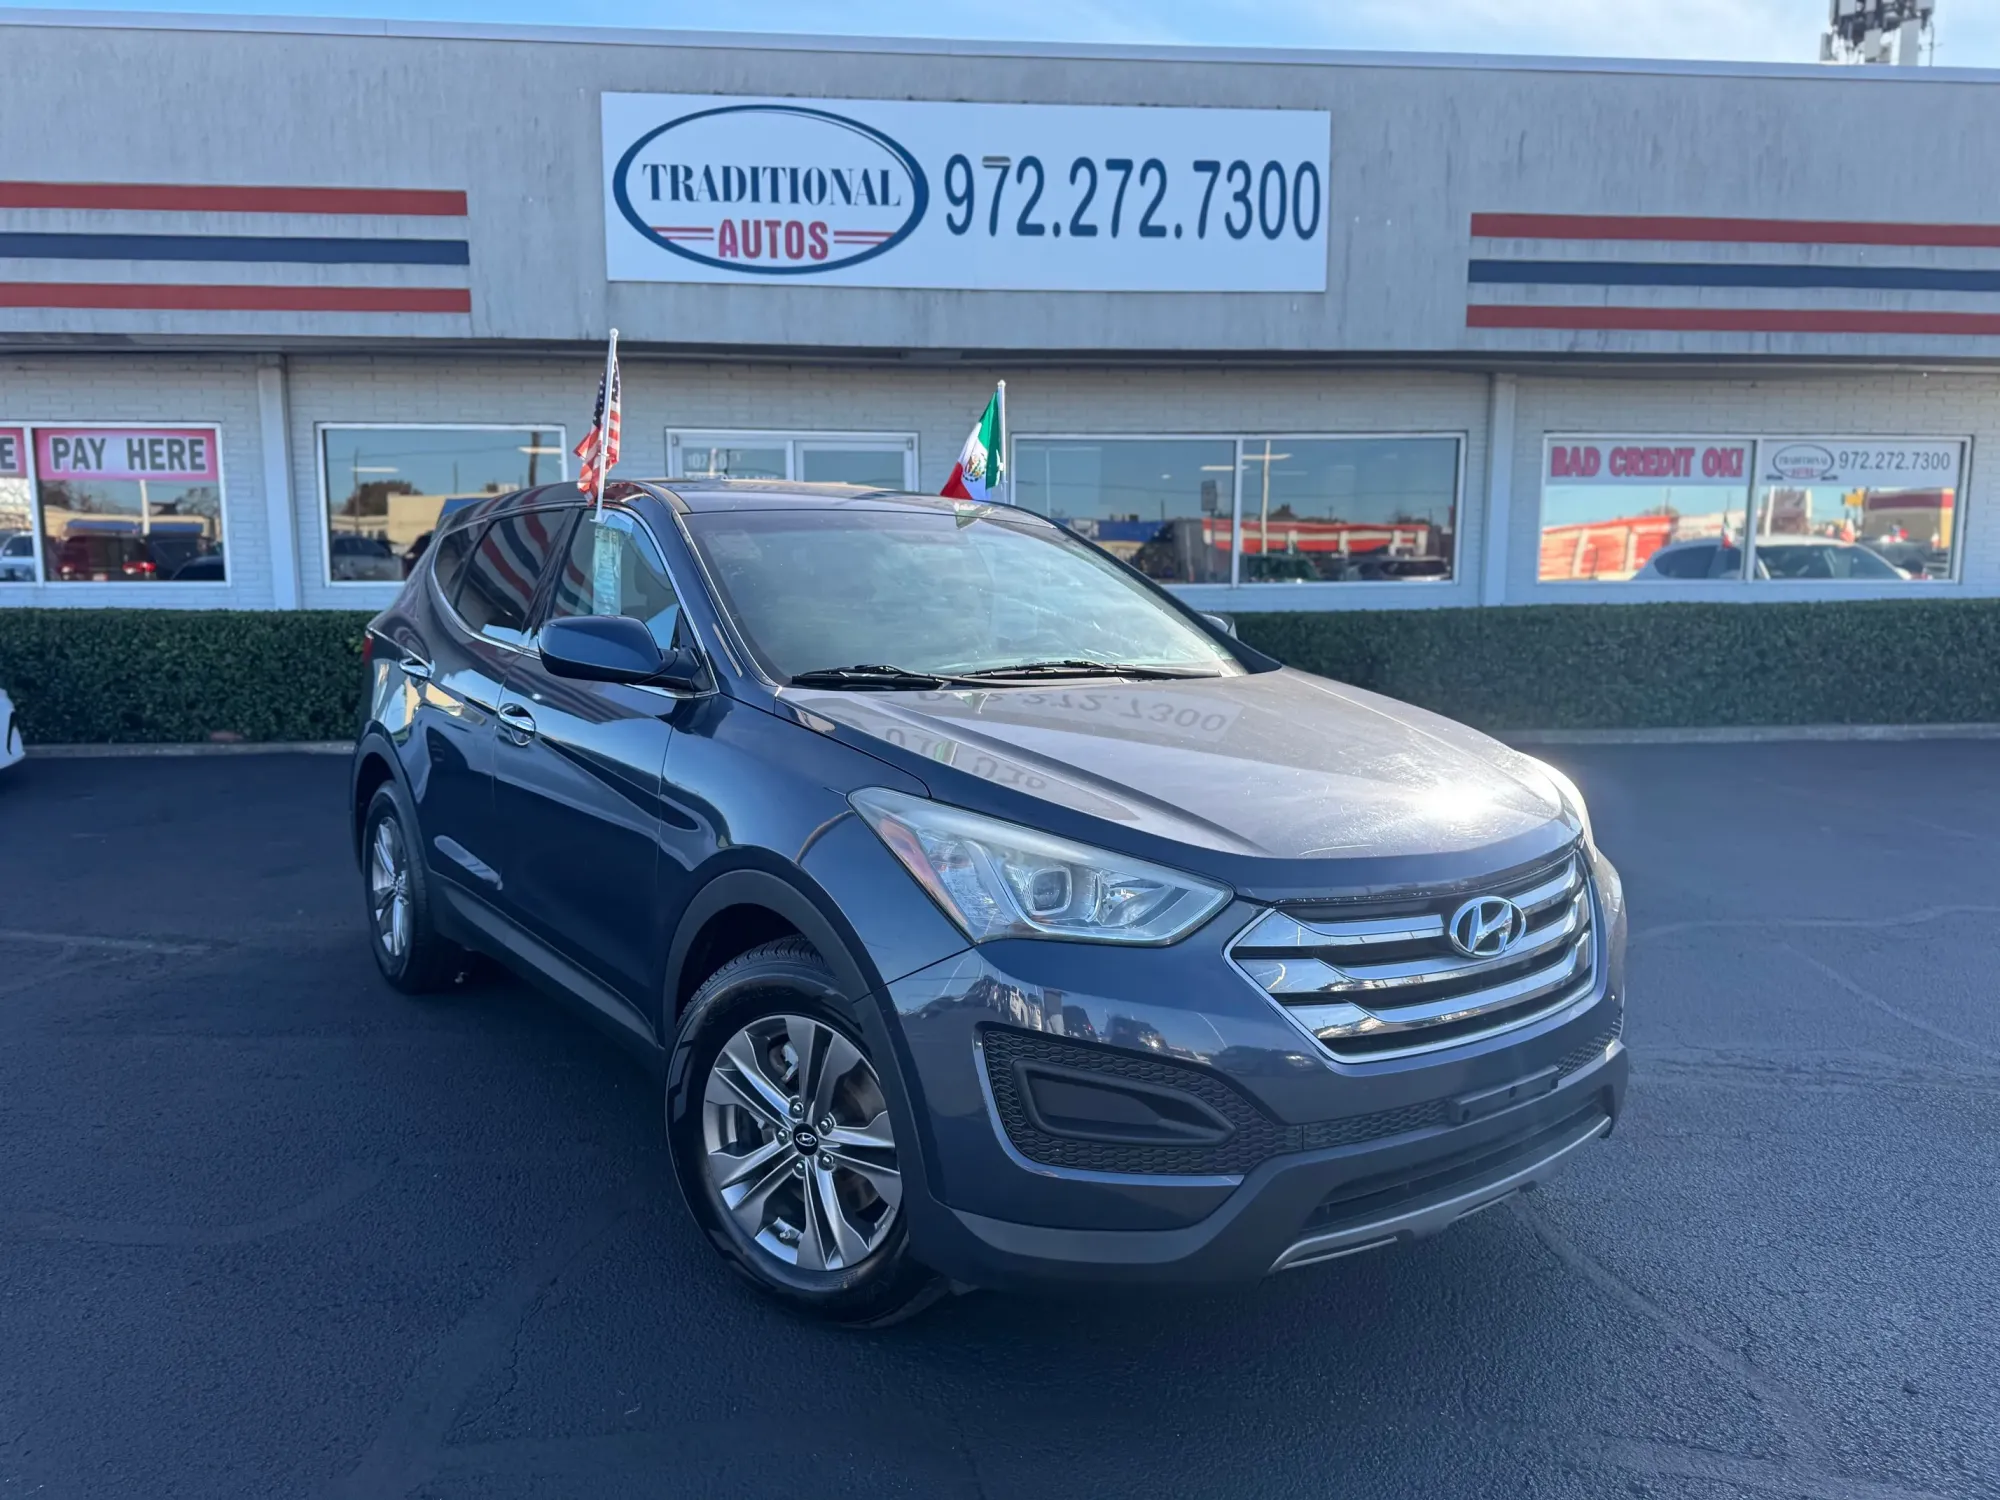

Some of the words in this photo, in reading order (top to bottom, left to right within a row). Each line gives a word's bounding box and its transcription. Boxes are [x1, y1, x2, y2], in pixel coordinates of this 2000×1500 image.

[642, 164, 901, 207] TRADITIONAL
[944, 153, 1321, 240] 972.272.7300
[718, 219, 829, 261] AUTOS
[52, 437, 106, 470] PAY
[126, 438, 207, 471] HERE
[1551, 446, 1601, 477] BAD
[1609, 446, 1696, 477] CREDIT
[1702, 447, 1745, 478] OK!
[1839, 450, 1951, 471] 972.272.7300
